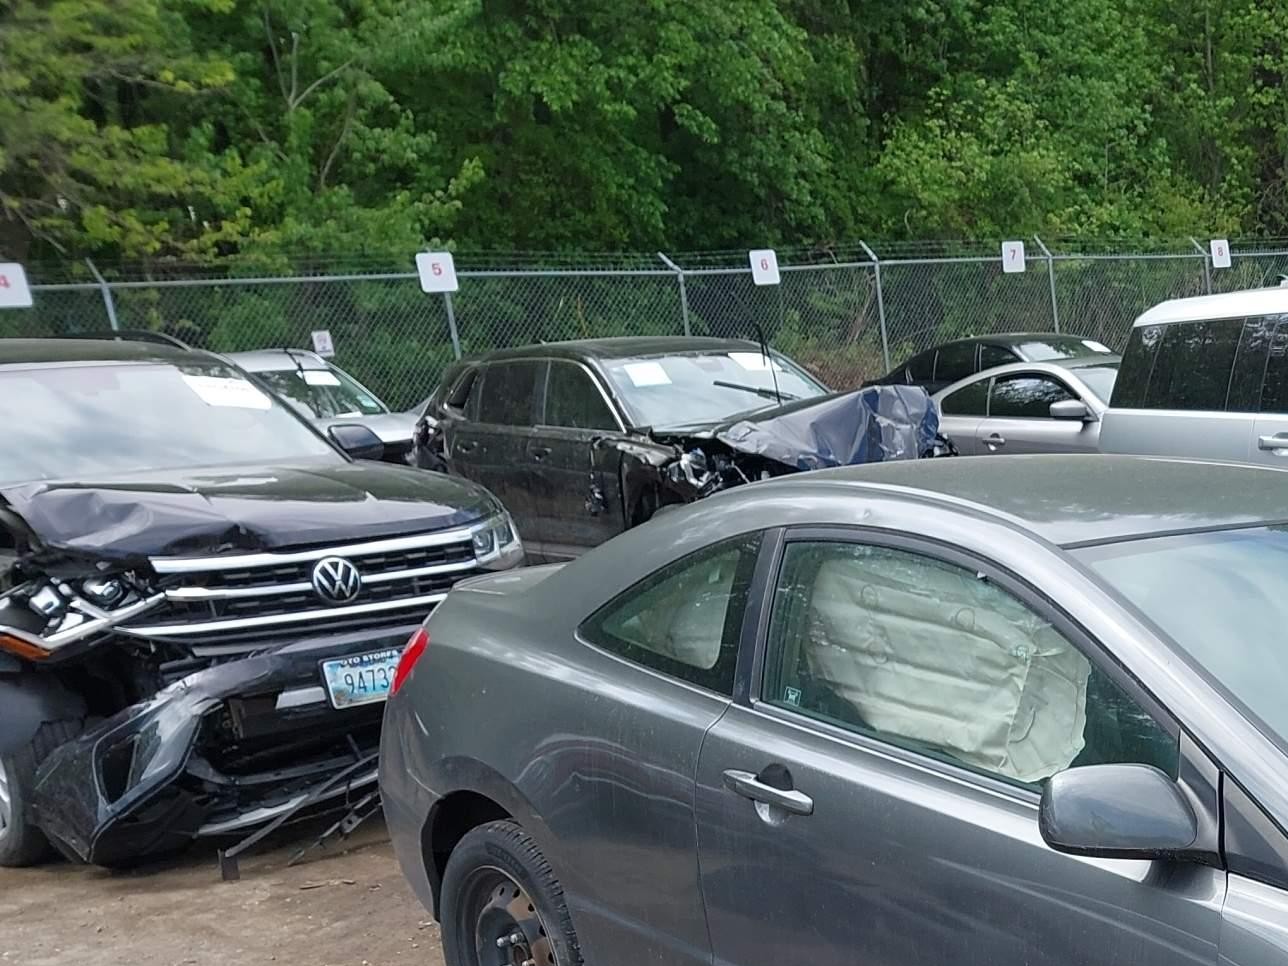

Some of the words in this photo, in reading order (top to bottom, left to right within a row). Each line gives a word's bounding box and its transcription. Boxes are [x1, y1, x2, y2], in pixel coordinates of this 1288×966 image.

[1010, 248, 1016, 260] 7
[1217, 247, 1224, 257] 8
[431, 262, 442, 276] 5
[760, 258, 769, 271] 6
